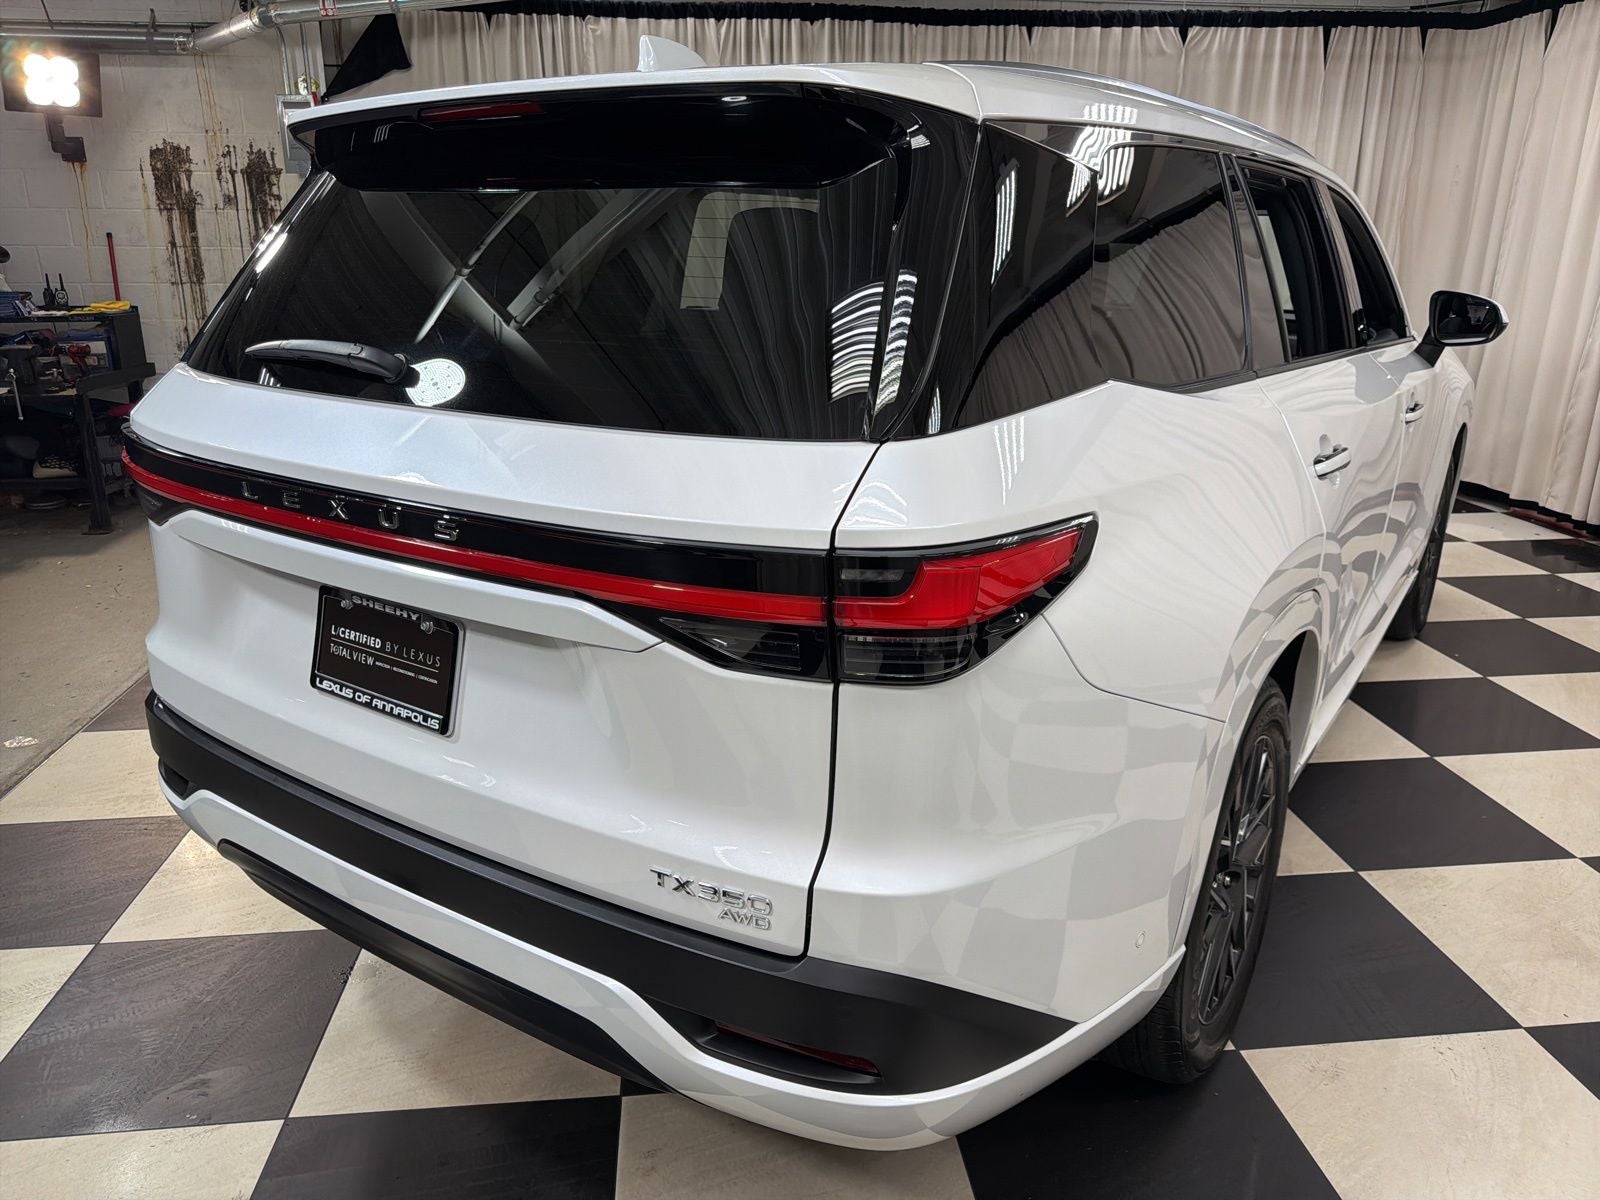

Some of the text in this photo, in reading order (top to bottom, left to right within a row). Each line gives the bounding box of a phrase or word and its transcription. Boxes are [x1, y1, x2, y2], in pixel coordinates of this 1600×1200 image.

[241, 481, 460, 542] LEXUS
[351, 595, 421, 621] SHEEHY
[331, 624, 441, 668] L/CERTIFIED BY LEXUS
[315, 677, 440, 730] LEXUS OF ANNAPOLIS
[718, 907, 772, 931] AWD
